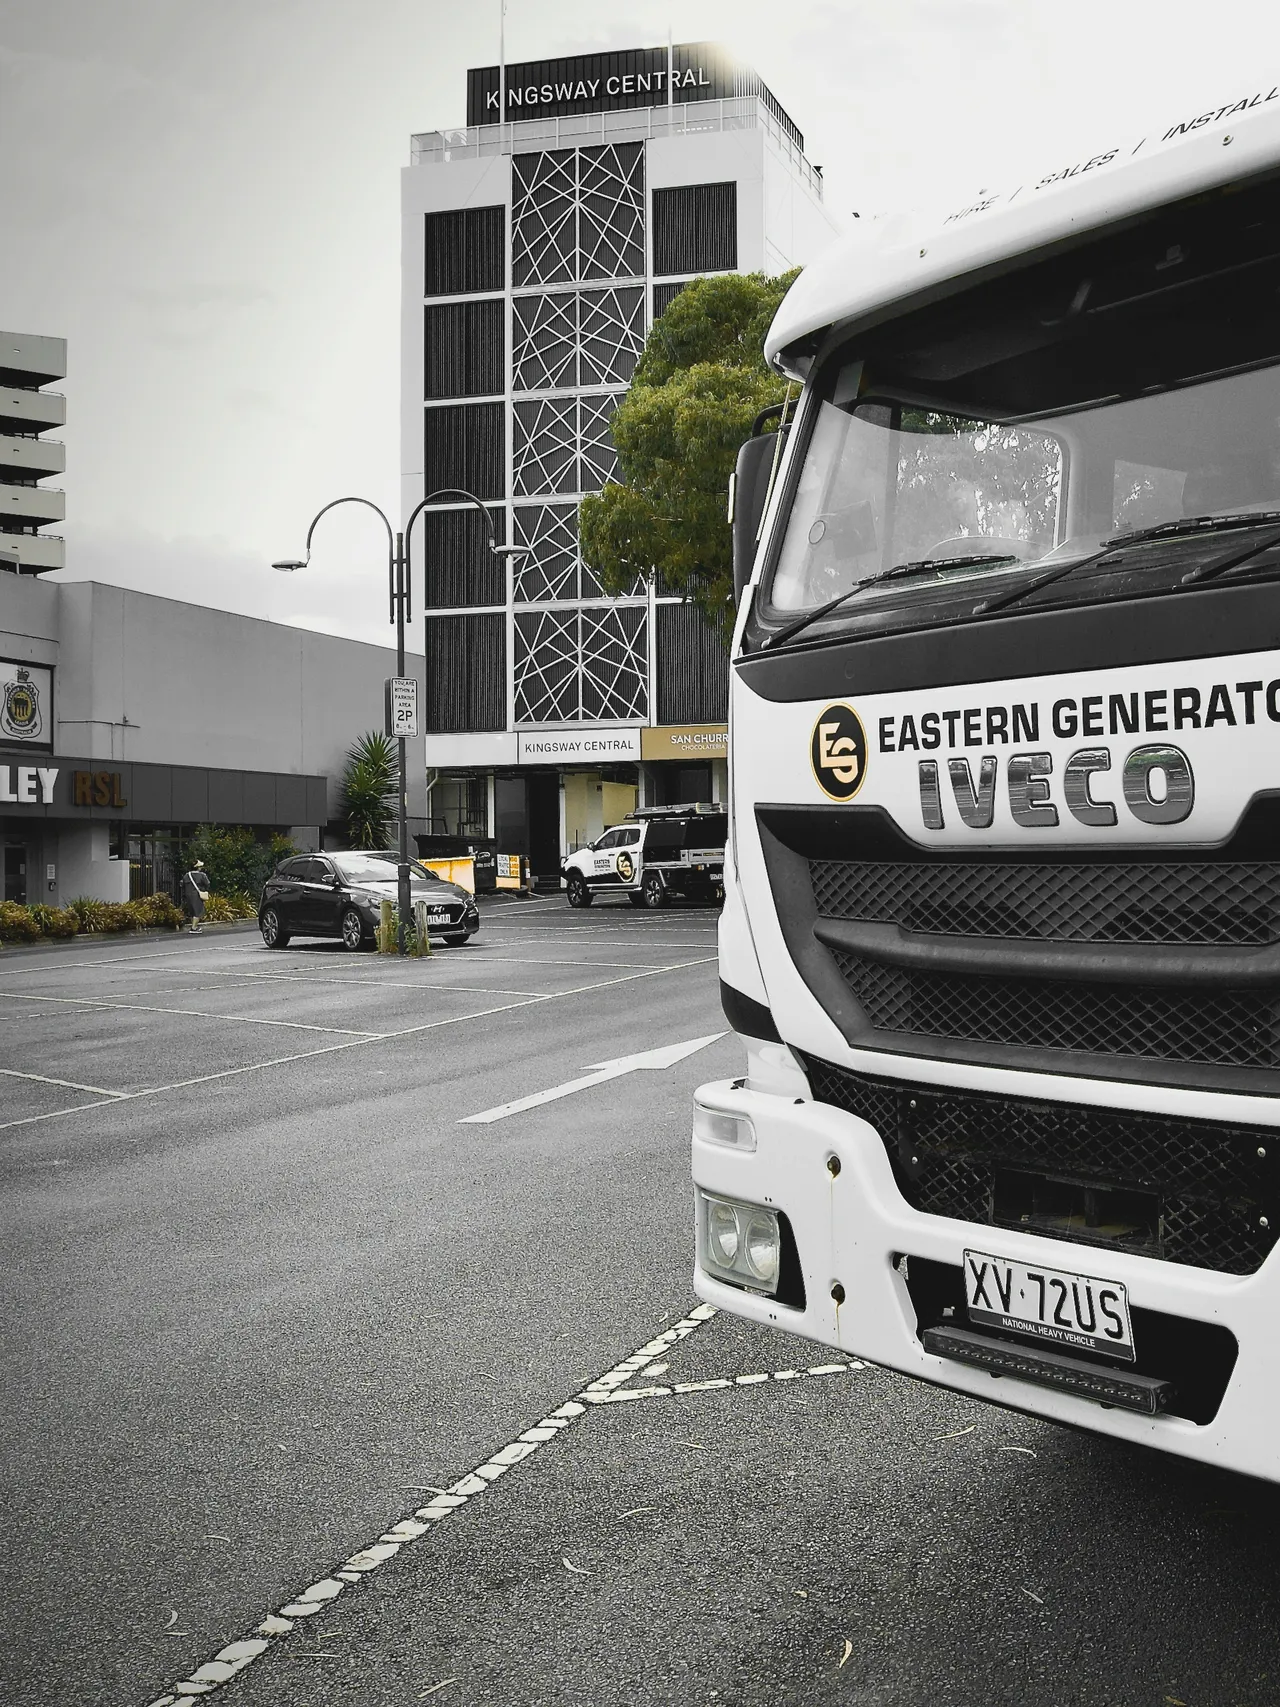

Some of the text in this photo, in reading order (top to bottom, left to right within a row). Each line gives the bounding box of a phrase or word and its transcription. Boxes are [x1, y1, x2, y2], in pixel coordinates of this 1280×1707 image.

[486, 67, 711, 110] KNGSWAY CENTRAL
[943, 195, 1000, 225] HIRE
[1035, 148, 1120, 190] SALES
[1161, 86, 1280, 142] INSTALL
[397, 709, 413, 721] 2P
[879, 703, 1040, 755] EASTERN
[525, 740, 634, 752] KINGSWAY CENTRAL
[671, 734, 691, 744] SAN
[74, 771, 128, 807] RSL
[918, 743, 1195, 830] IVECO
[1002, 1317, 1096, 1347] NATIONAL HEAVY VEHICLE
